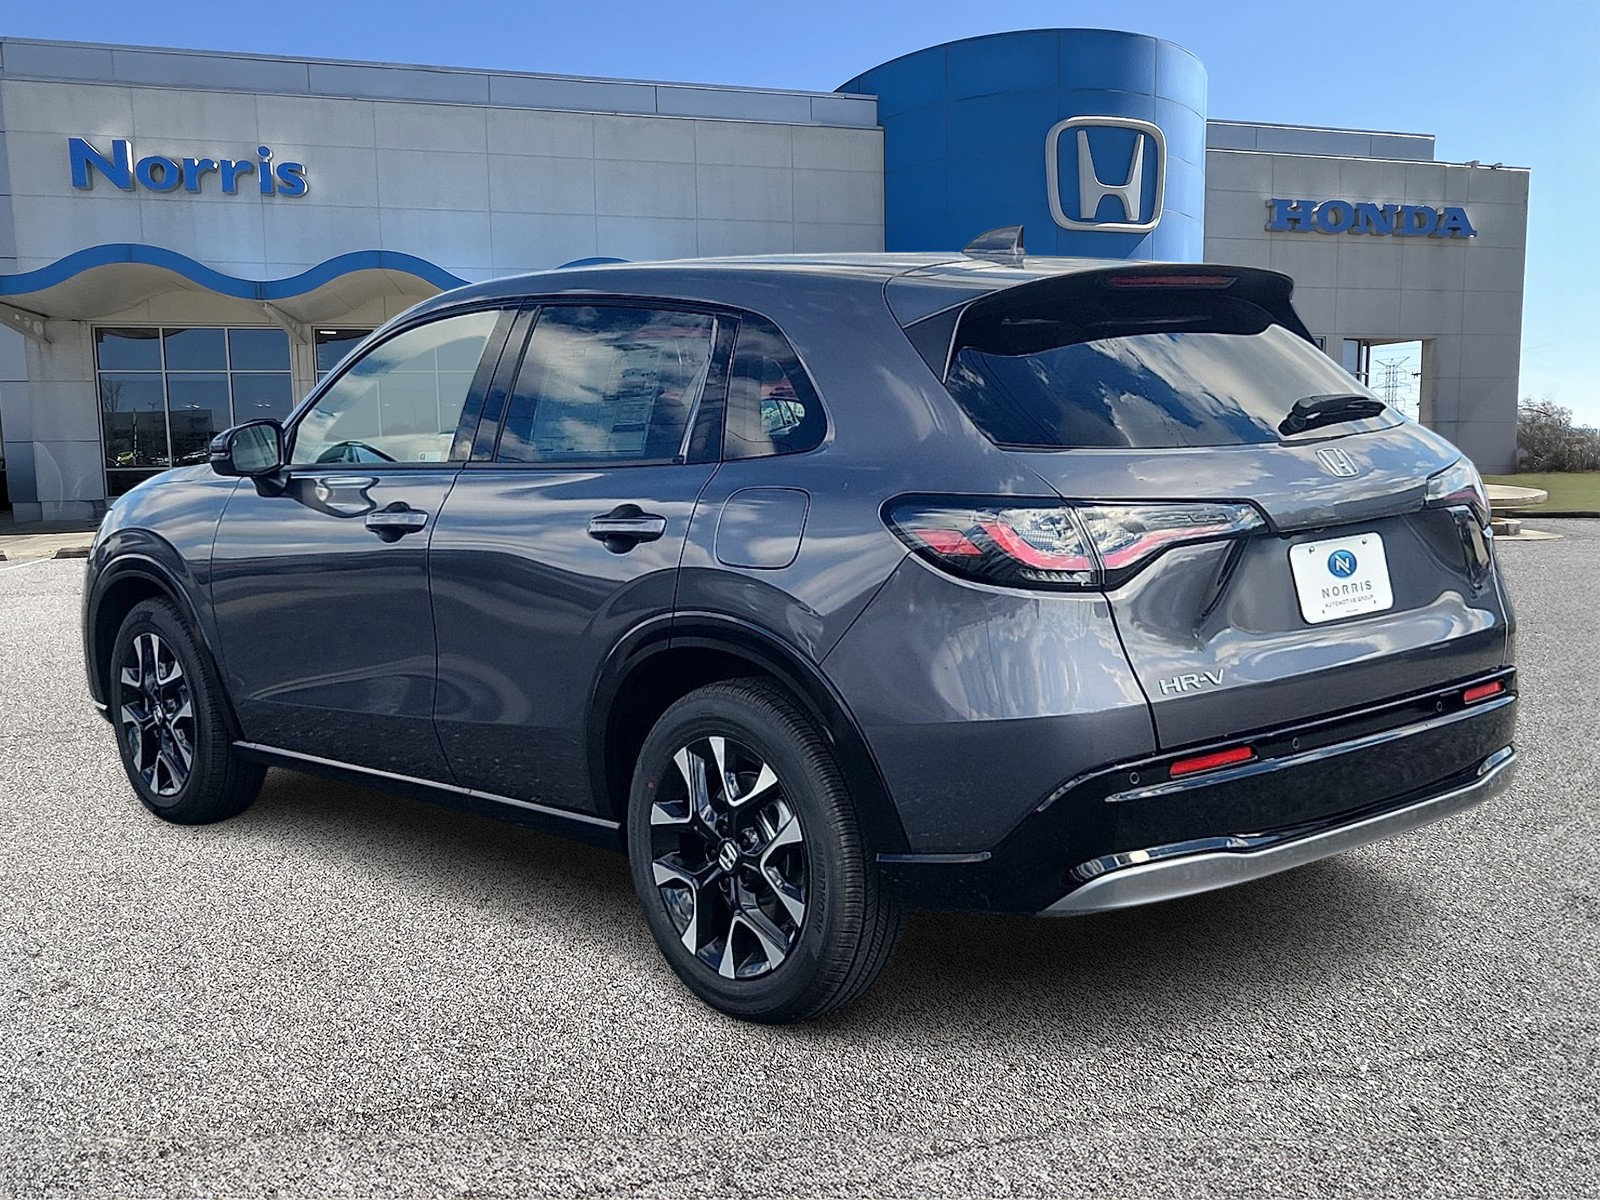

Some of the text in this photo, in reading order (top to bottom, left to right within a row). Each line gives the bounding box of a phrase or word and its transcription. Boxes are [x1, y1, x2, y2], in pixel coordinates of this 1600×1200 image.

[68, 136, 309, 198] Norris
[1265, 198, 1477, 238] HONDA
[1321, 580, 1373, 599] NORRIS
[1325, 597, 1357, 608] AUTOMOTIVE
[1159, 668, 1224, 695] HR-V
